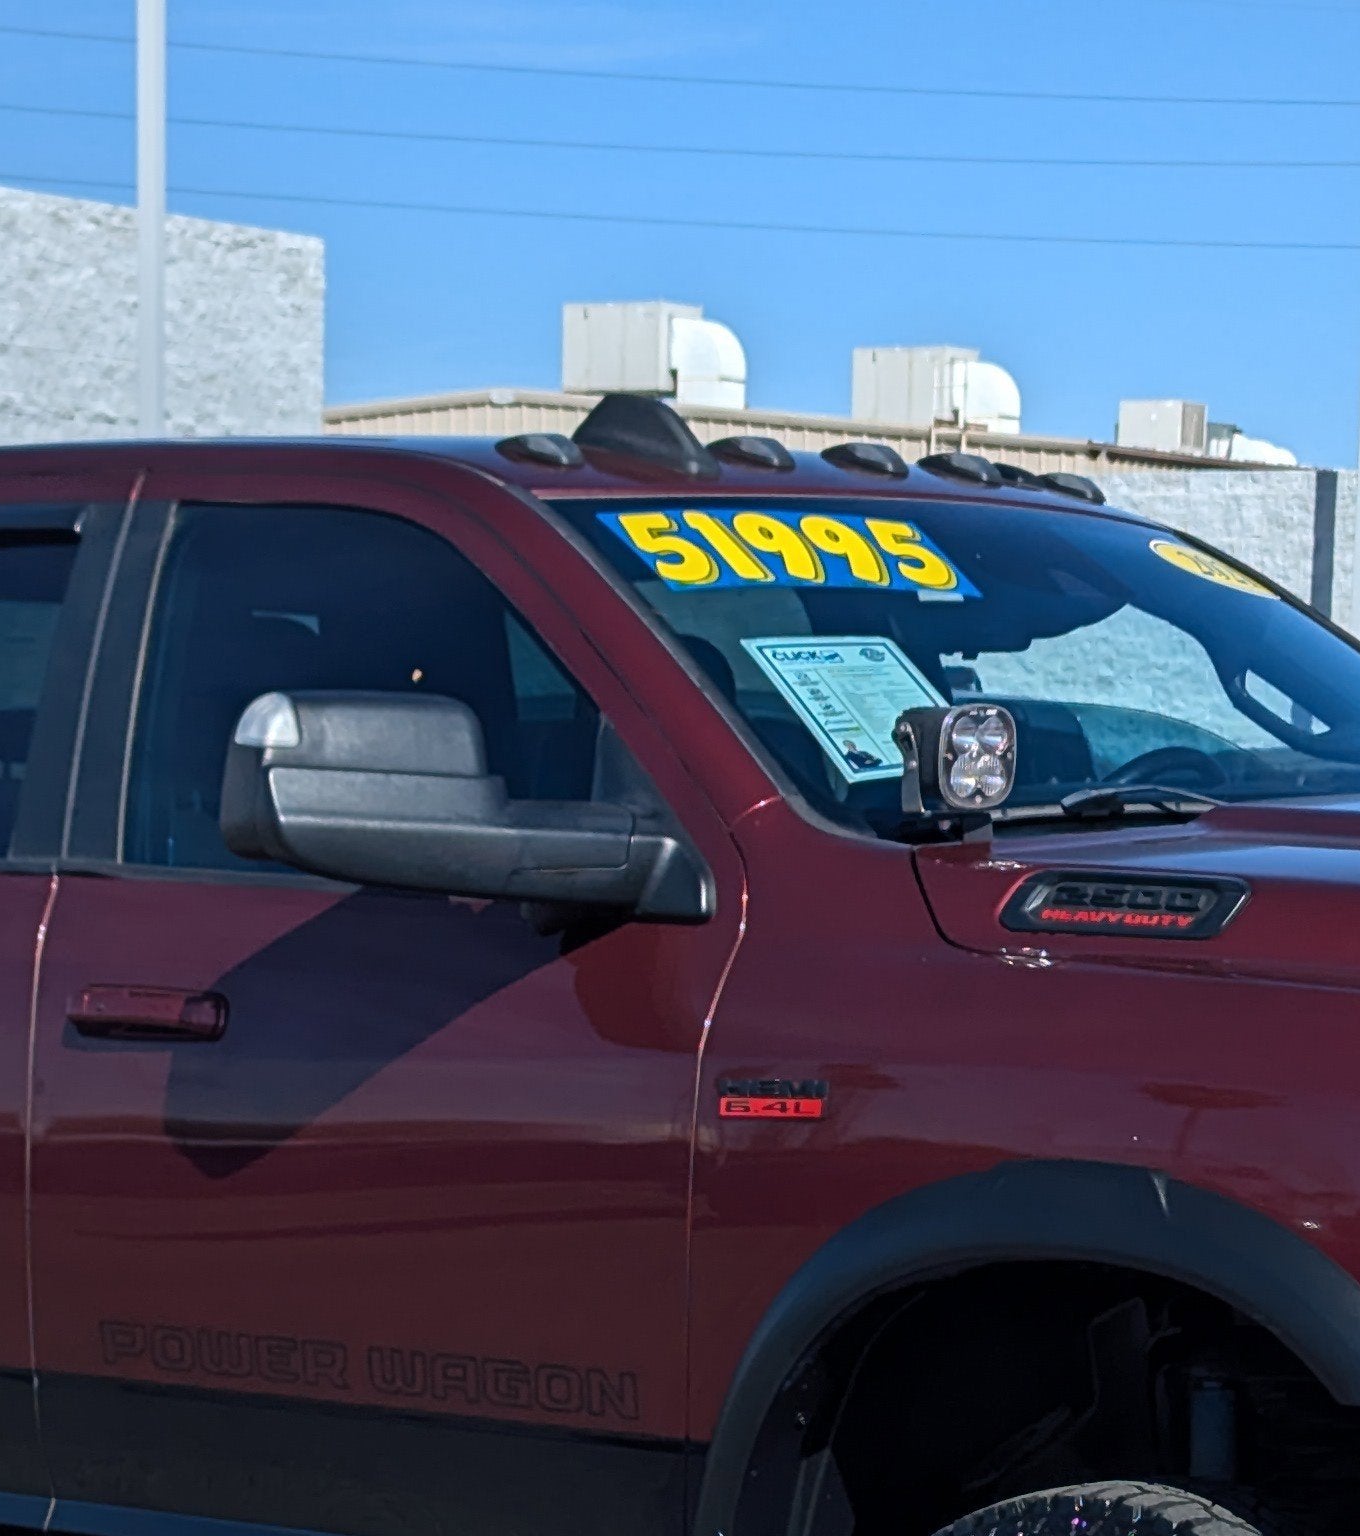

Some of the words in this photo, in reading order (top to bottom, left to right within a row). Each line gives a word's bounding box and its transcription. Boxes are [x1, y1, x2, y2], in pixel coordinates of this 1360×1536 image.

[618, 510, 958, 590] 51995
[1051, 884, 1203, 912] 2500
[1041, 909, 1121, 922] HEAVY
[1123, 912, 1194, 926] DUTY
[724, 1100, 816, 1115] 6.4L
[101, 1321, 349, 1387] POWER
[369, 1345, 640, 1420] WAGON
